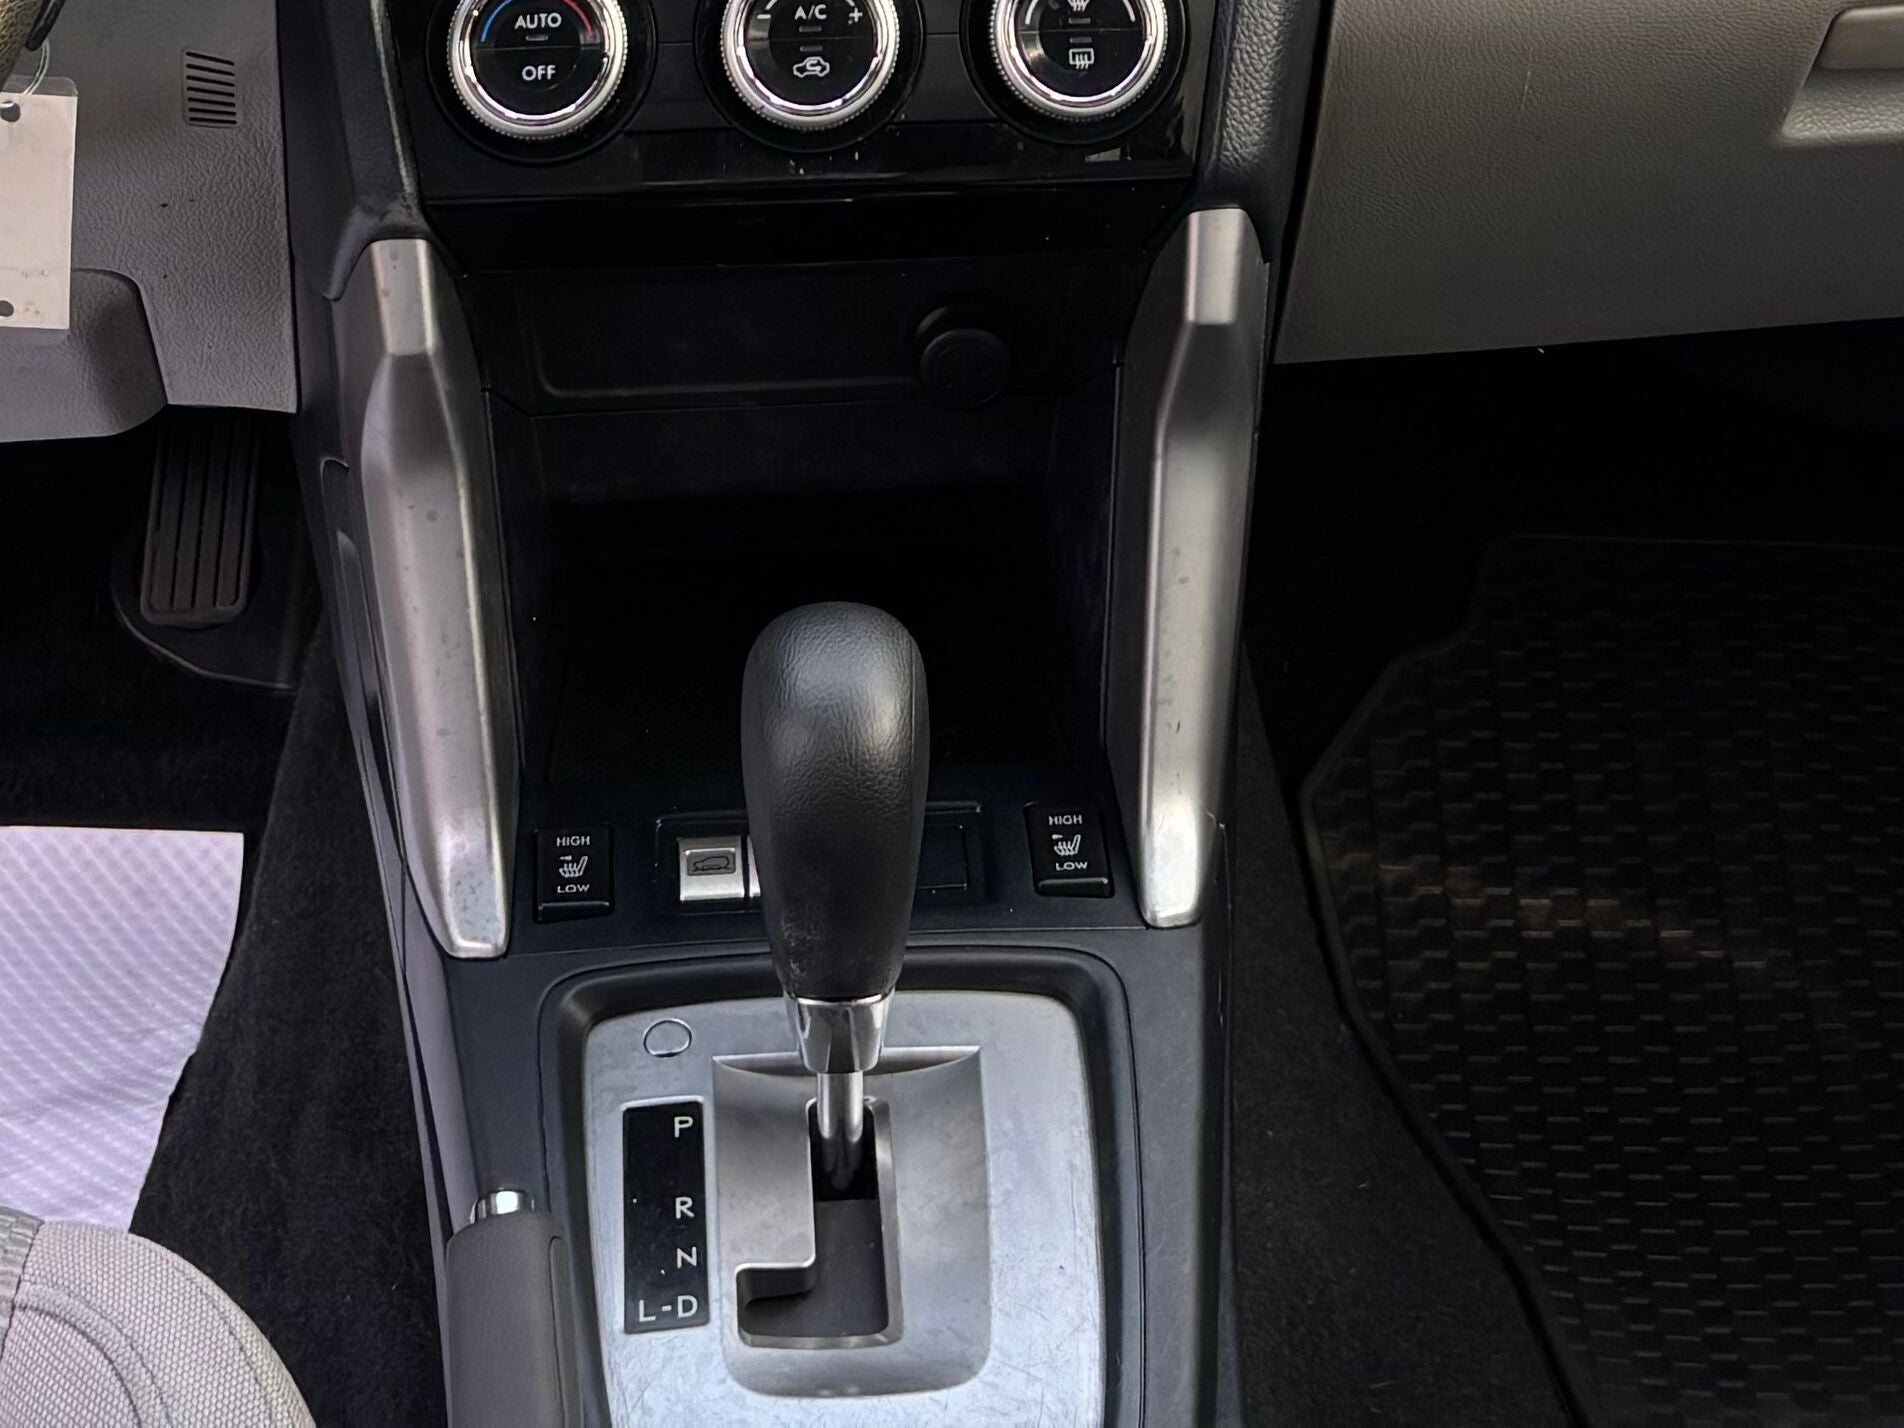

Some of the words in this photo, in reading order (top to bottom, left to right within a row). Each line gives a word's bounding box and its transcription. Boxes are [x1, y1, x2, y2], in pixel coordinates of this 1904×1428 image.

[514, 11, 563, 31] AUTO
[793, 3, 827, 23] A/C
[521, 64, 557, 83] OFF
[1047, 814, 1083, 826] HIGH
[555, 835, 591, 847] HIGH
[1054, 860, 1089, 871] LOW
[556, 883, 590, 894] LOW
[672, 1116, 694, 1138] P
[674, 1196, 696, 1219] R
[676, 1246, 698, 1269] N
